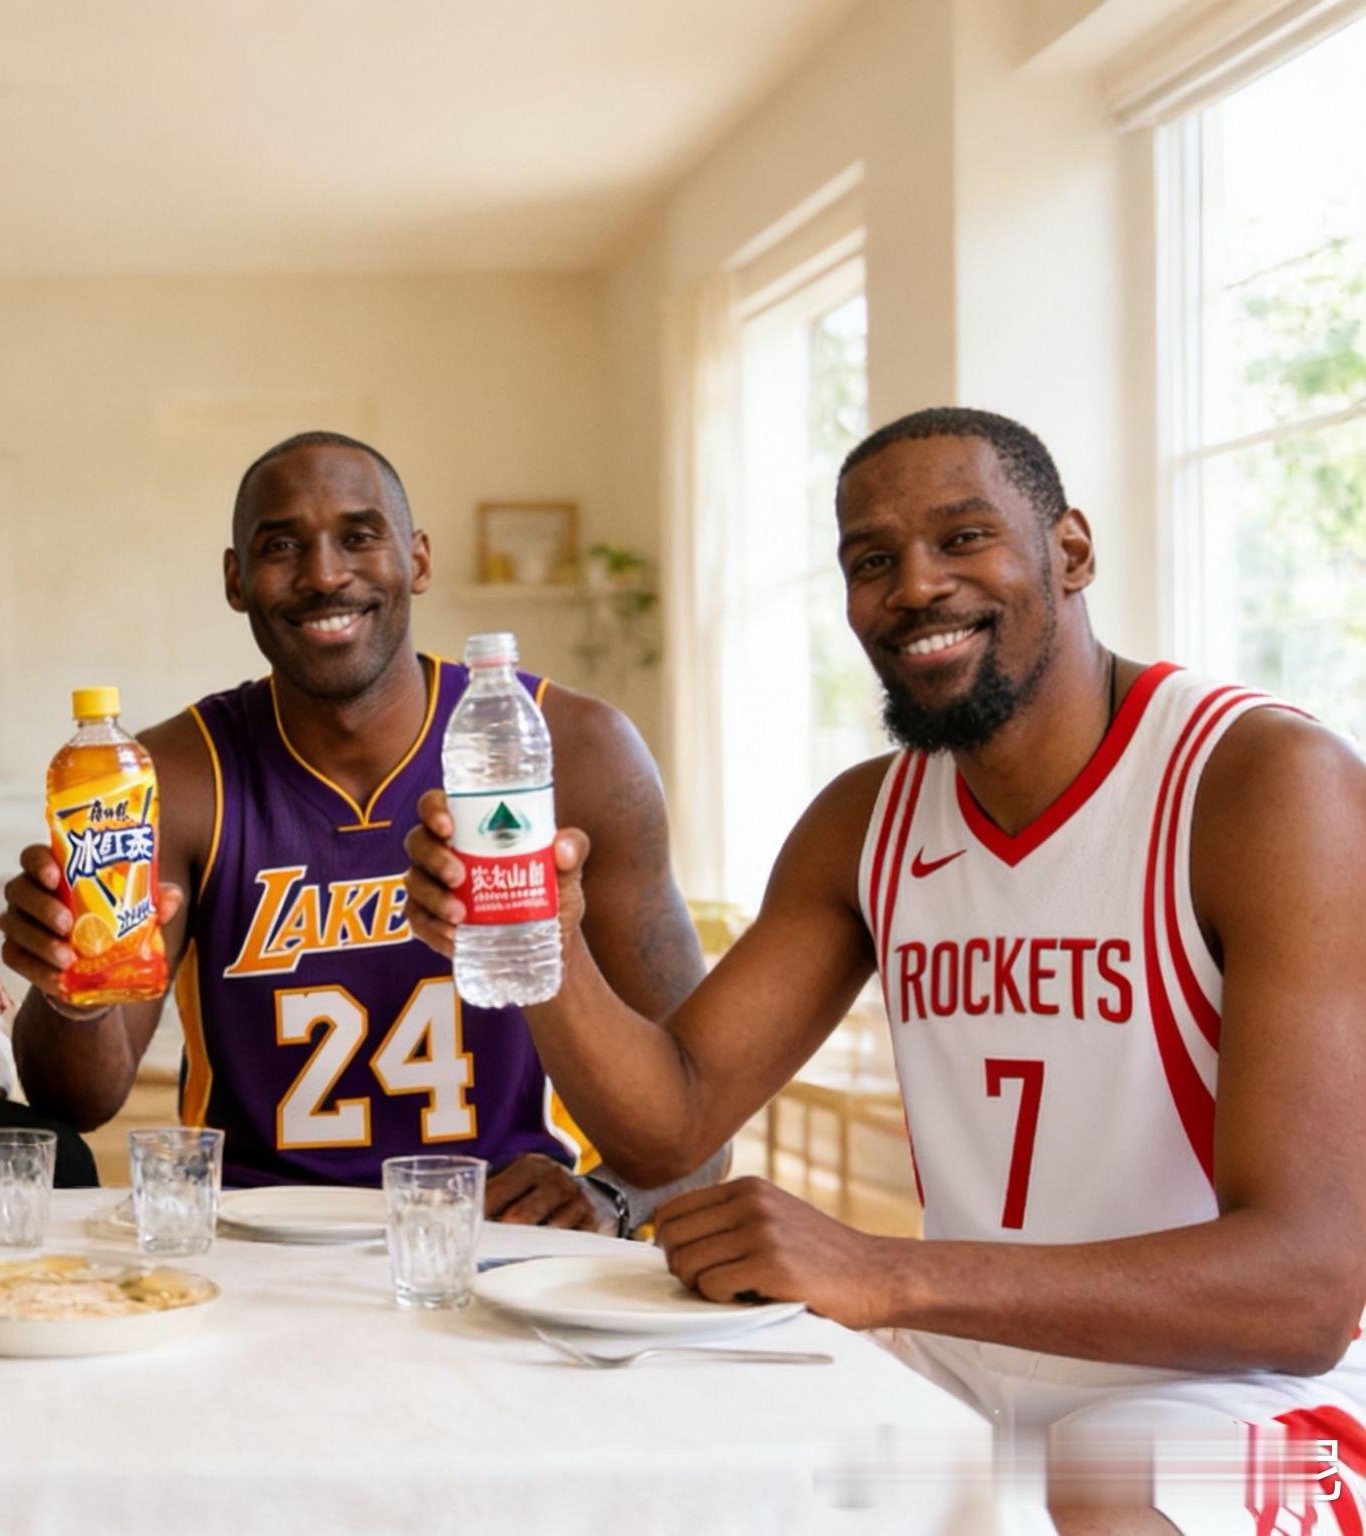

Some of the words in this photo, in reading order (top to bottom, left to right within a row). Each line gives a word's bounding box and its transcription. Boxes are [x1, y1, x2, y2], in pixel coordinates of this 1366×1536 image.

[223, 865, 413, 979] LAKE
[895, 936, 1133, 1024] ROCKETS
[274, 975, 478, 1150] 24
[984, 1057, 1045, 1230] 7
